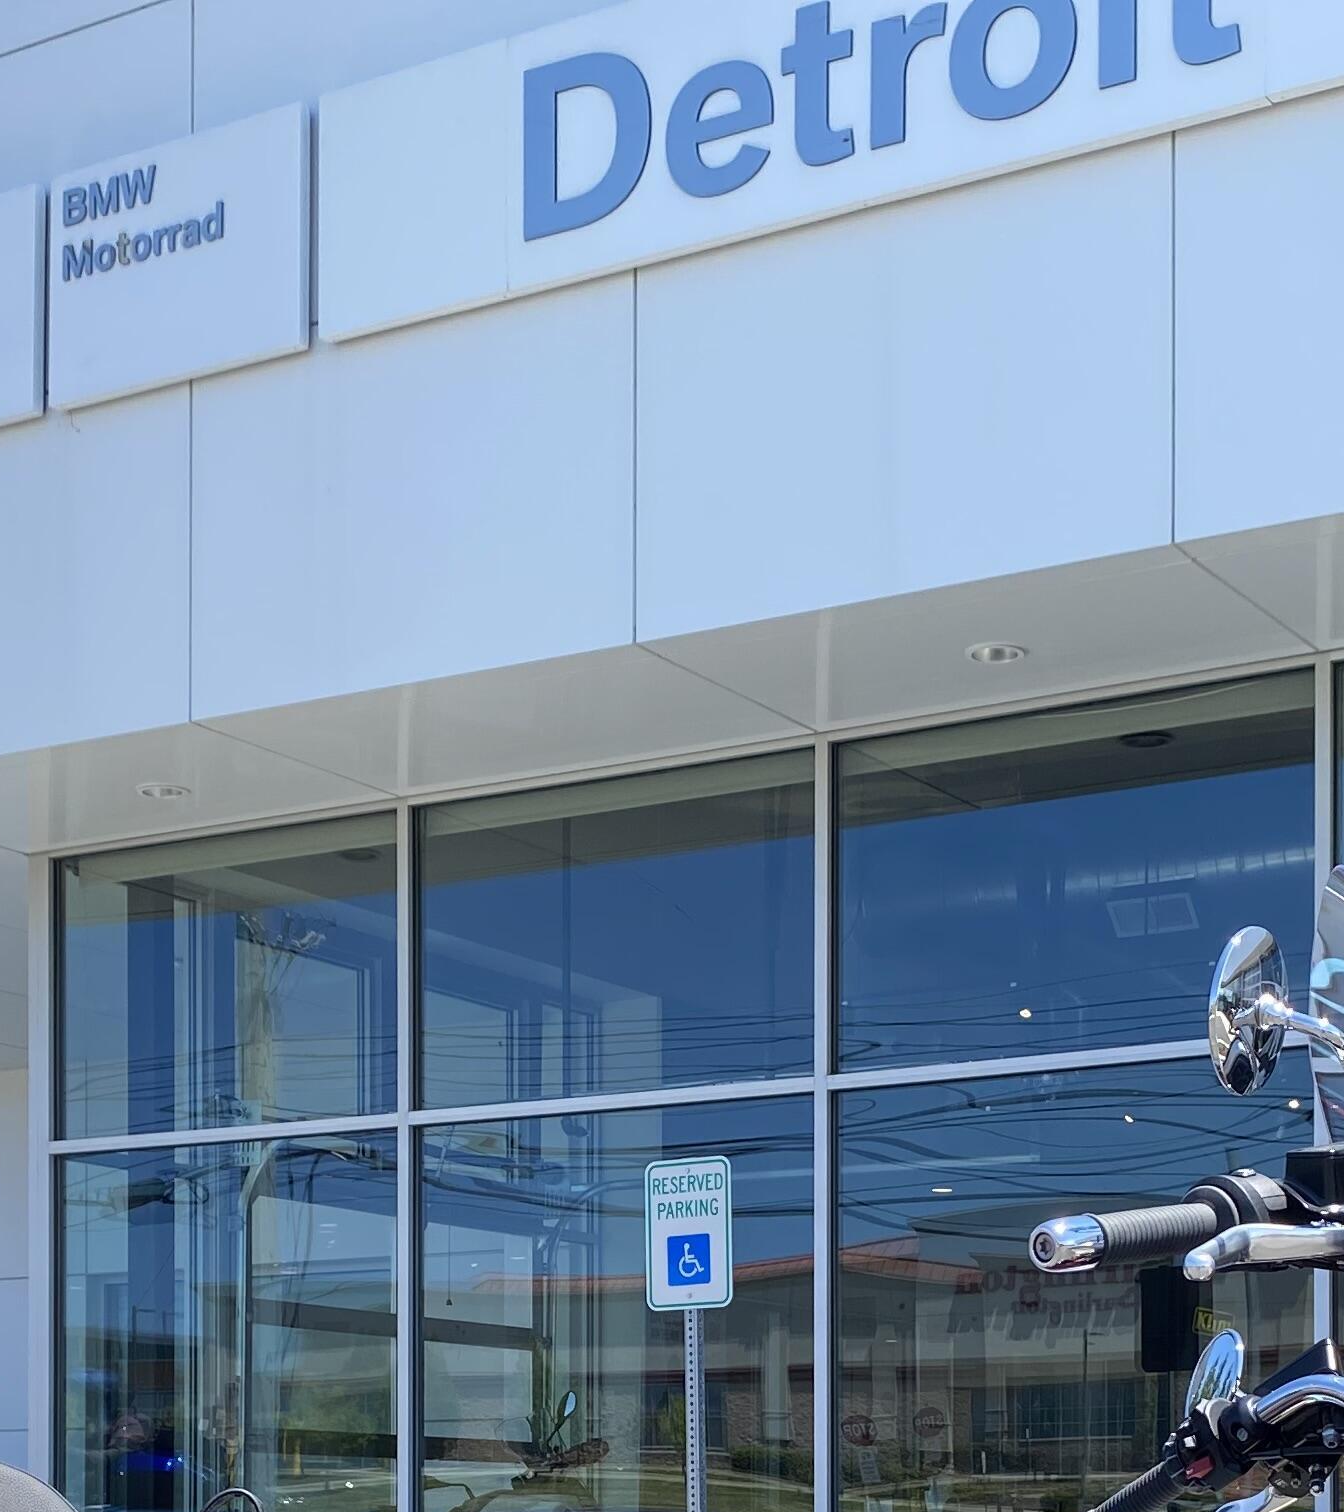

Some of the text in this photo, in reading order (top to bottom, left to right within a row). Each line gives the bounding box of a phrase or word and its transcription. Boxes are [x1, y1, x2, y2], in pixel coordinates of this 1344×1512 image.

[61, 164, 157, 227] BMW
[62, 200, 226, 282] Motorrad
[652, 1172, 724, 1196] RESERVED
[657, 1198, 719, 1221] PARKING
